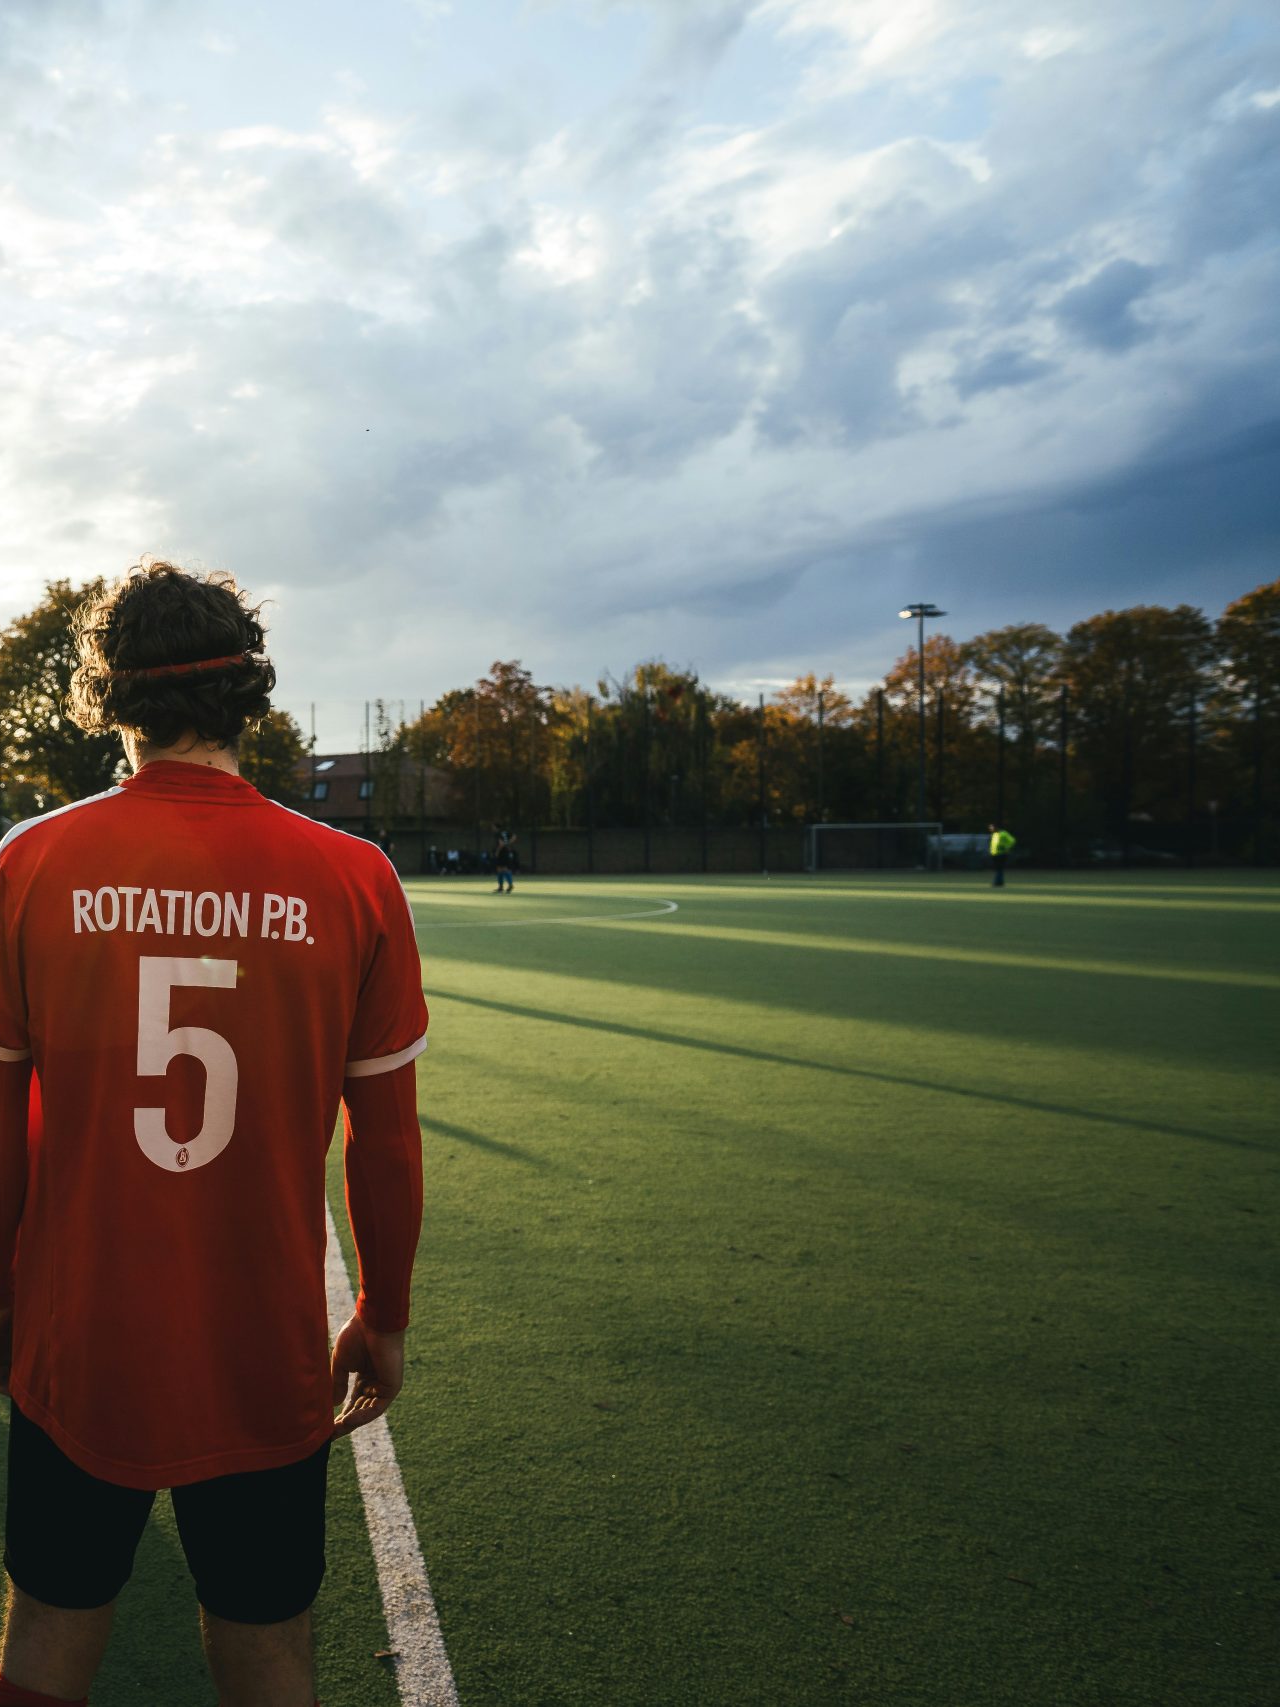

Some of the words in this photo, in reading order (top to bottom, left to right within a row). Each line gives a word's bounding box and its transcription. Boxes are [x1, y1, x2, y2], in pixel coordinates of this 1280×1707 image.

[73, 886, 250, 938] ROTATION
[261, 893, 315, 945] P.B.
[133, 955, 239, 1173] 5
